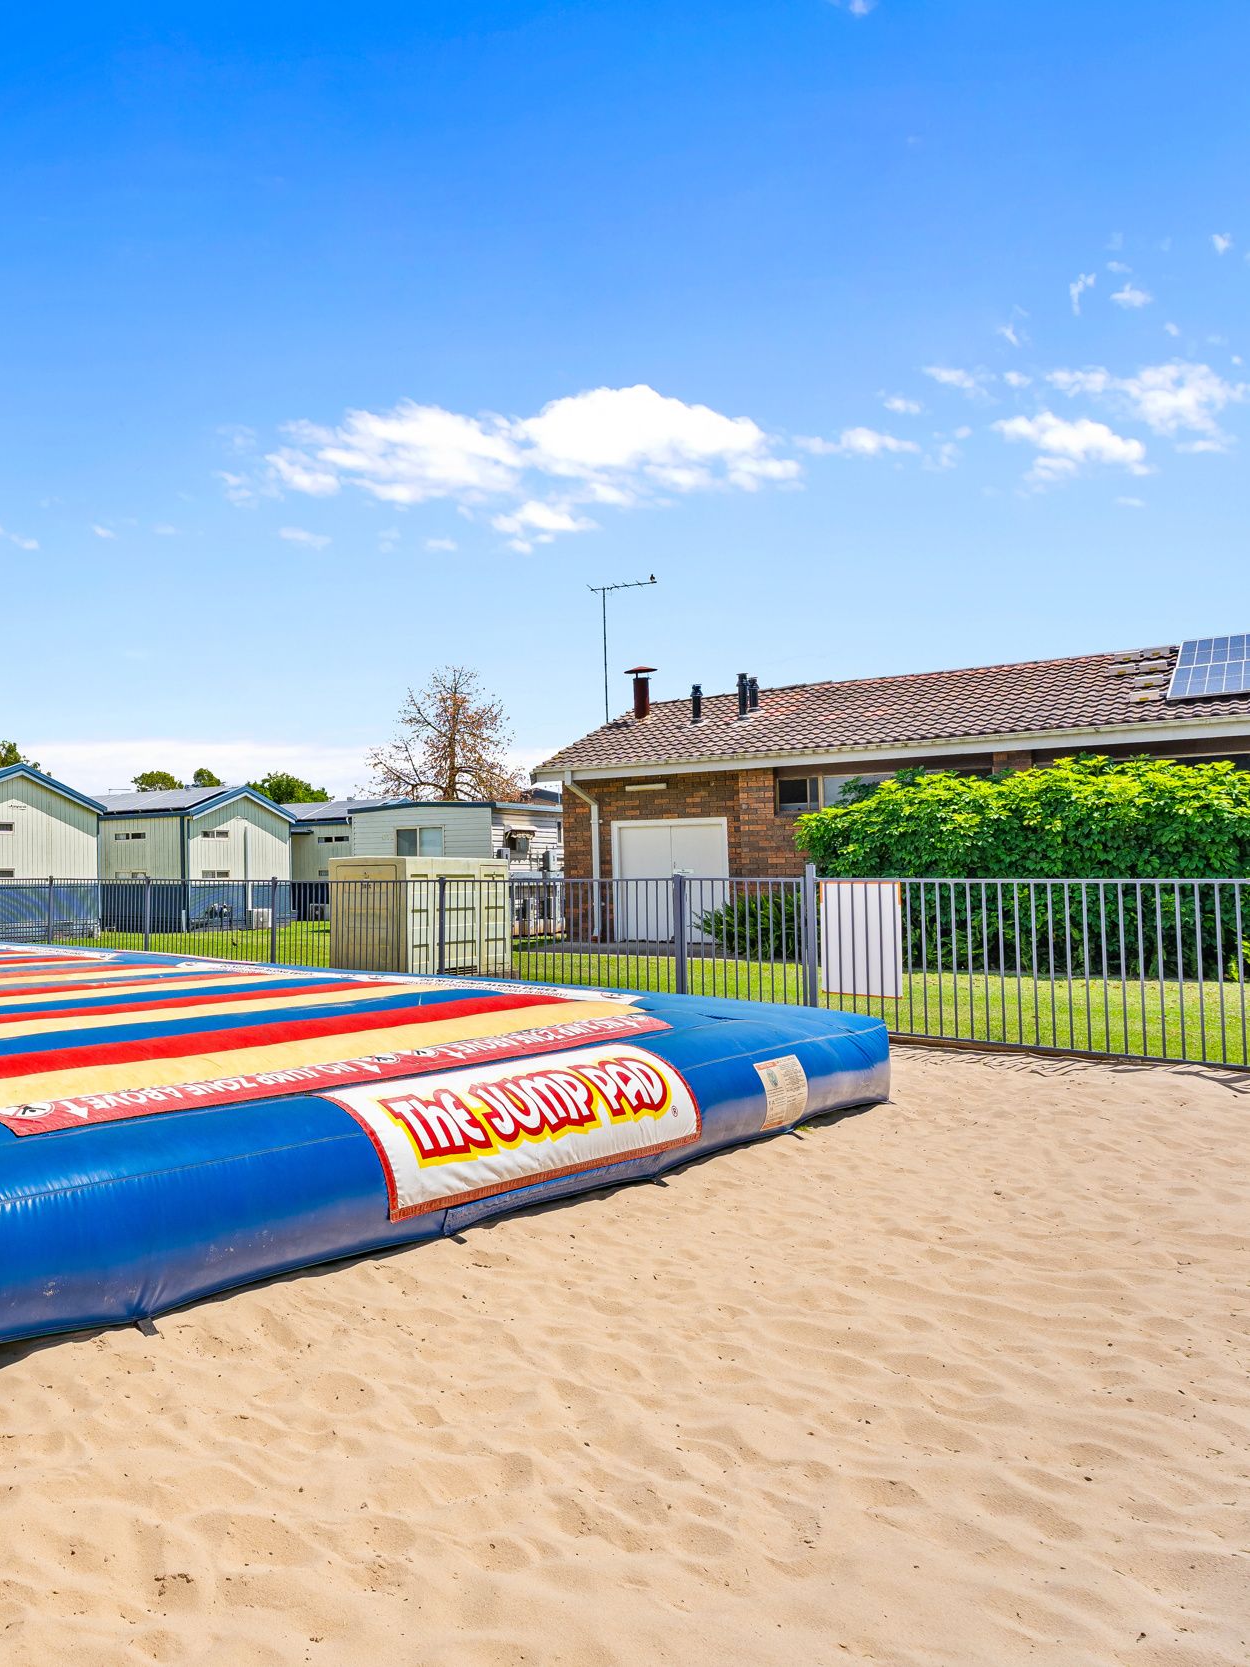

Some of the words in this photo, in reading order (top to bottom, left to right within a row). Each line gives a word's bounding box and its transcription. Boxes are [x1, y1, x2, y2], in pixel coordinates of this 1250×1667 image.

[178, 1073, 258, 1096] ZONE
[256, 1065, 320, 1085] JUMP
[85, 1086, 183, 1109] ABOVE
[464, 1070, 595, 1139] JUMP
[573, 1057, 666, 1114] PAD
